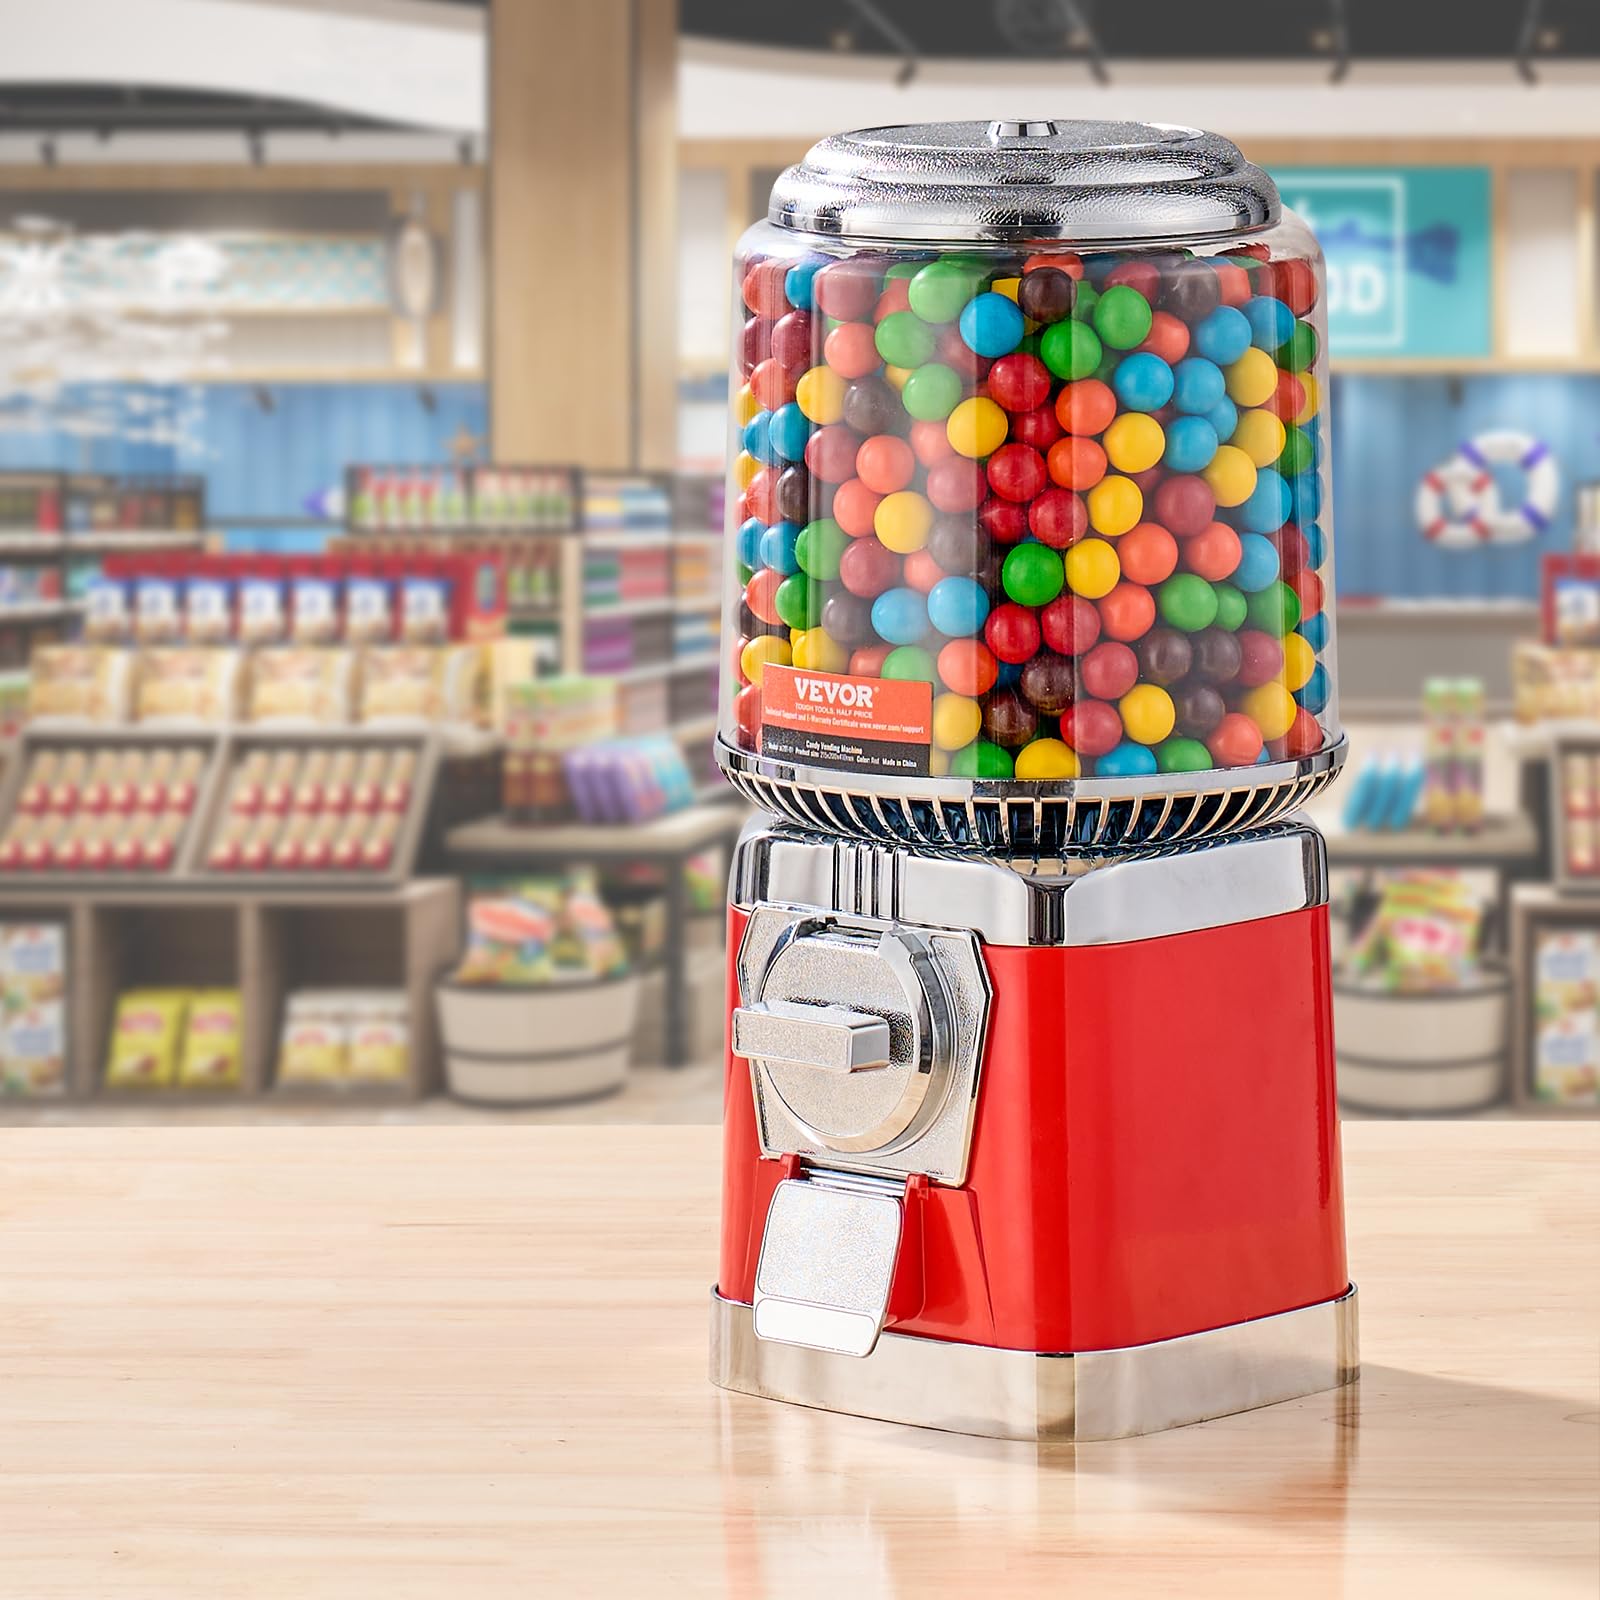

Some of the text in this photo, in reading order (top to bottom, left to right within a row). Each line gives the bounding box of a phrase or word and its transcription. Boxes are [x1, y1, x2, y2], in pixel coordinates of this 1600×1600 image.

[794, 677, 873, 708] VEVOR
[795, 702, 814, 711] TOUGH
[836, 708, 852, 716] HALF
[853, 710, 873, 719] PRICE
[832, 718, 859, 729] Certificate
[805, 740, 820, 751] Candy
[820, 741, 840, 753] Vending
[841, 744, 863, 755] Machine
[882, 757, 896, 767] Made
[902, 759, 917, 768] China
